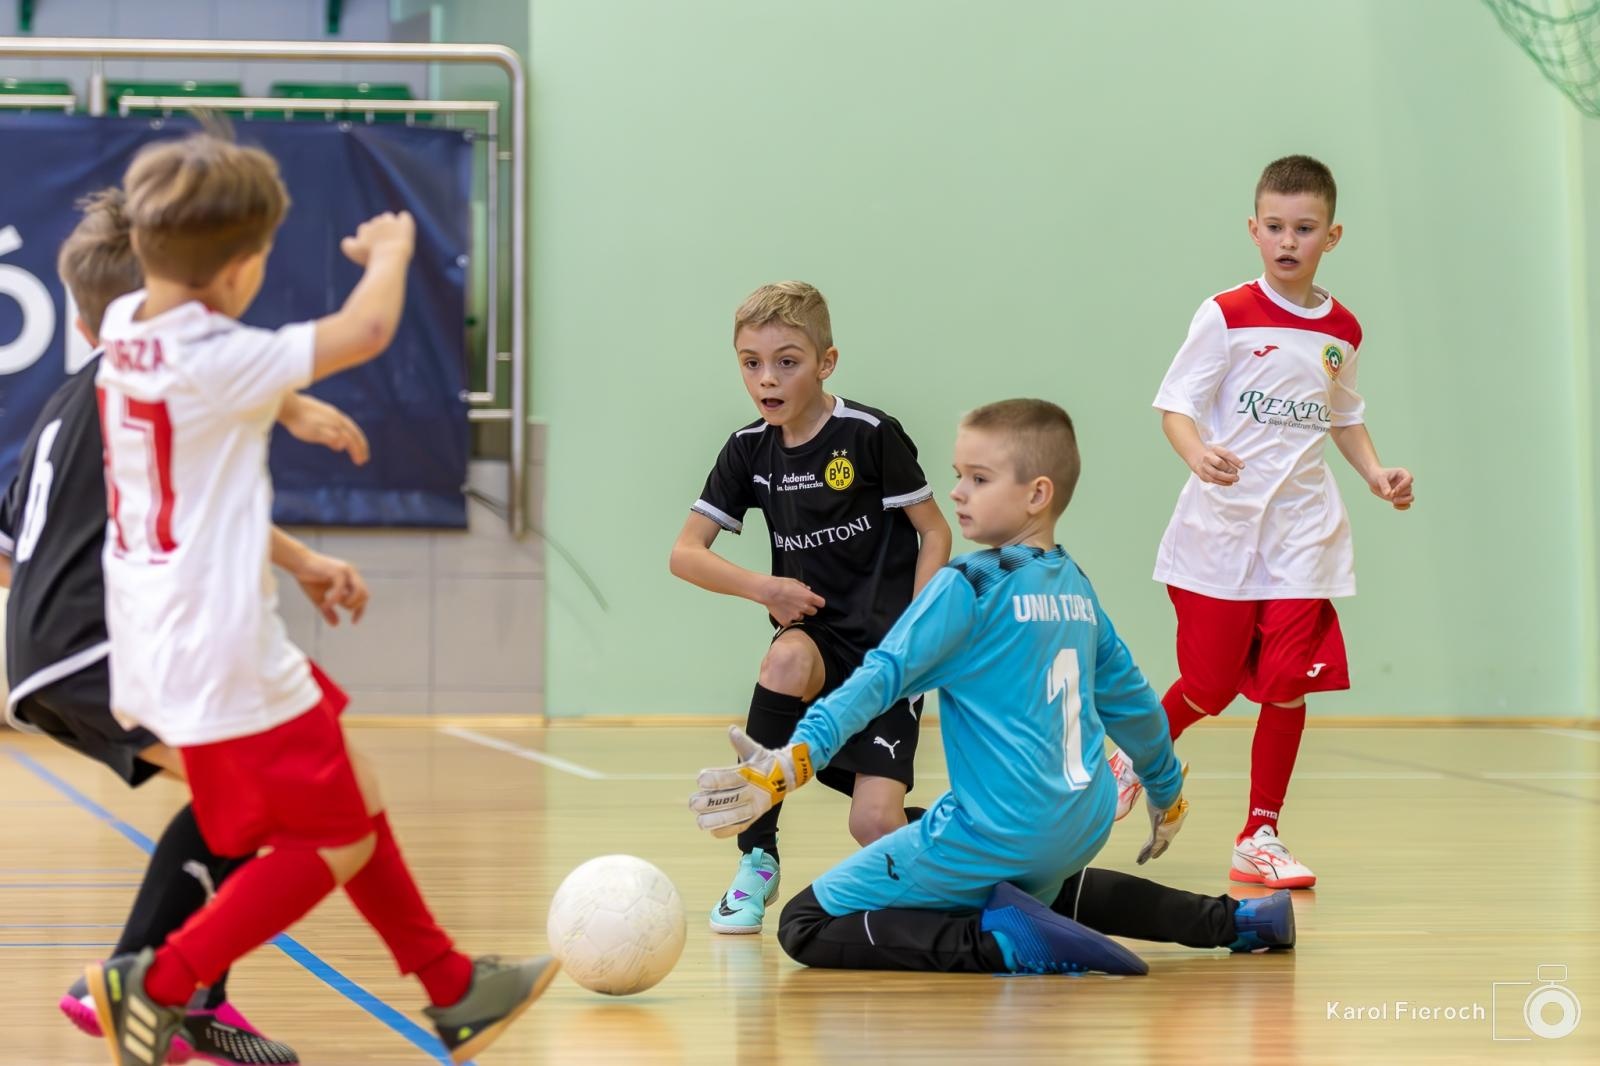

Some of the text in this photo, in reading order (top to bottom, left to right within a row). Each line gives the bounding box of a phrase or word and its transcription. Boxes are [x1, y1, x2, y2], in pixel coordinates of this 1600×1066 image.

[830, 461, 850, 480] BVB
[835, 479, 845, 487] 09
[1013, 594, 1060, 623] UNIA
[1047, 648, 1091, 790] 1
